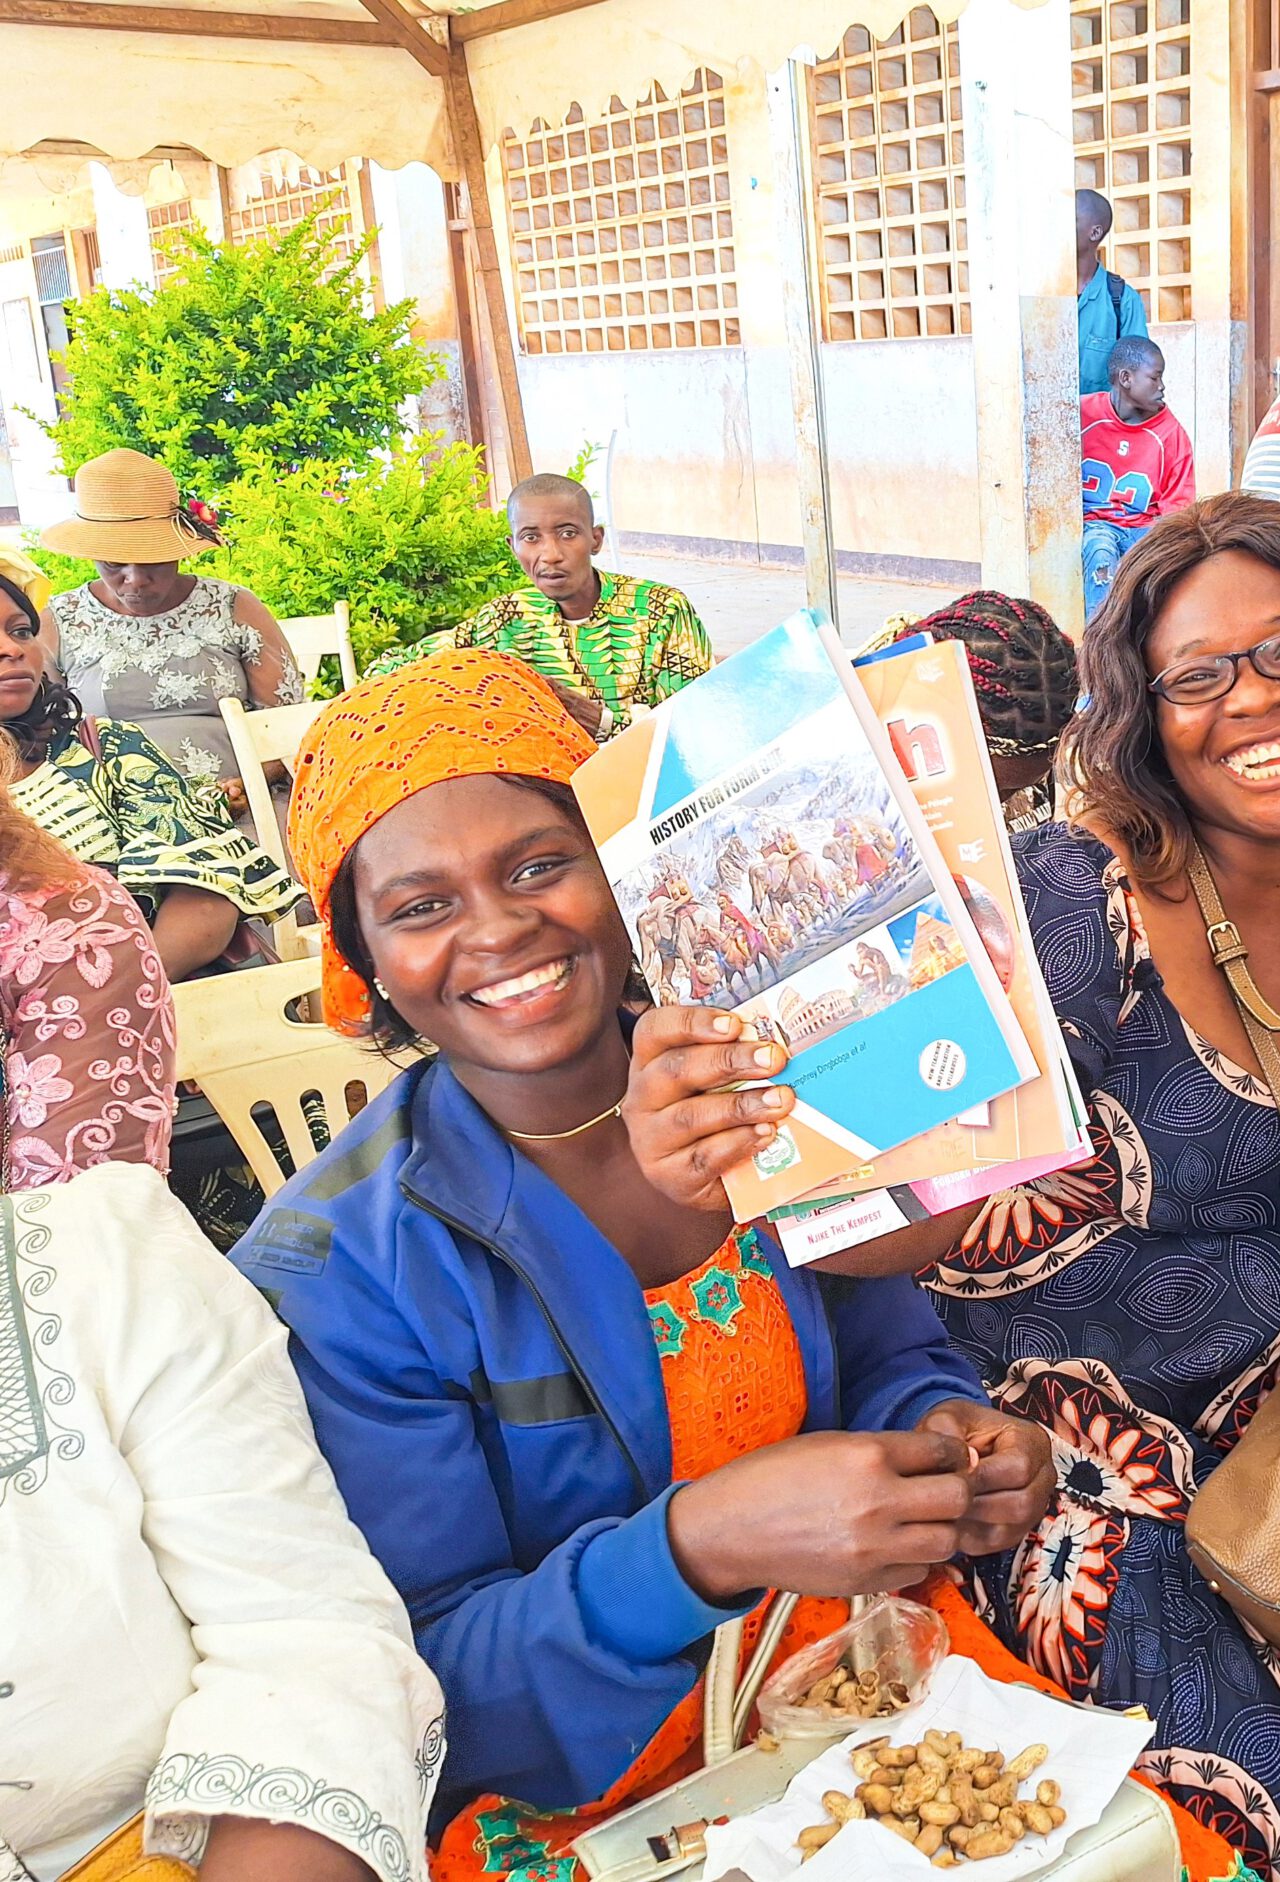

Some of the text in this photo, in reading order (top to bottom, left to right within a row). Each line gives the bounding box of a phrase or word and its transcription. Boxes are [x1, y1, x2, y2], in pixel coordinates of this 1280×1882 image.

[1116, 440, 1130, 456] S
[649, 802, 699, 846] HISTORY
[698, 787, 725, 814] FOR
[722, 766, 760, 798] FORM
[807, 1210, 882, 1245] NJIKE THE KEMPEST
